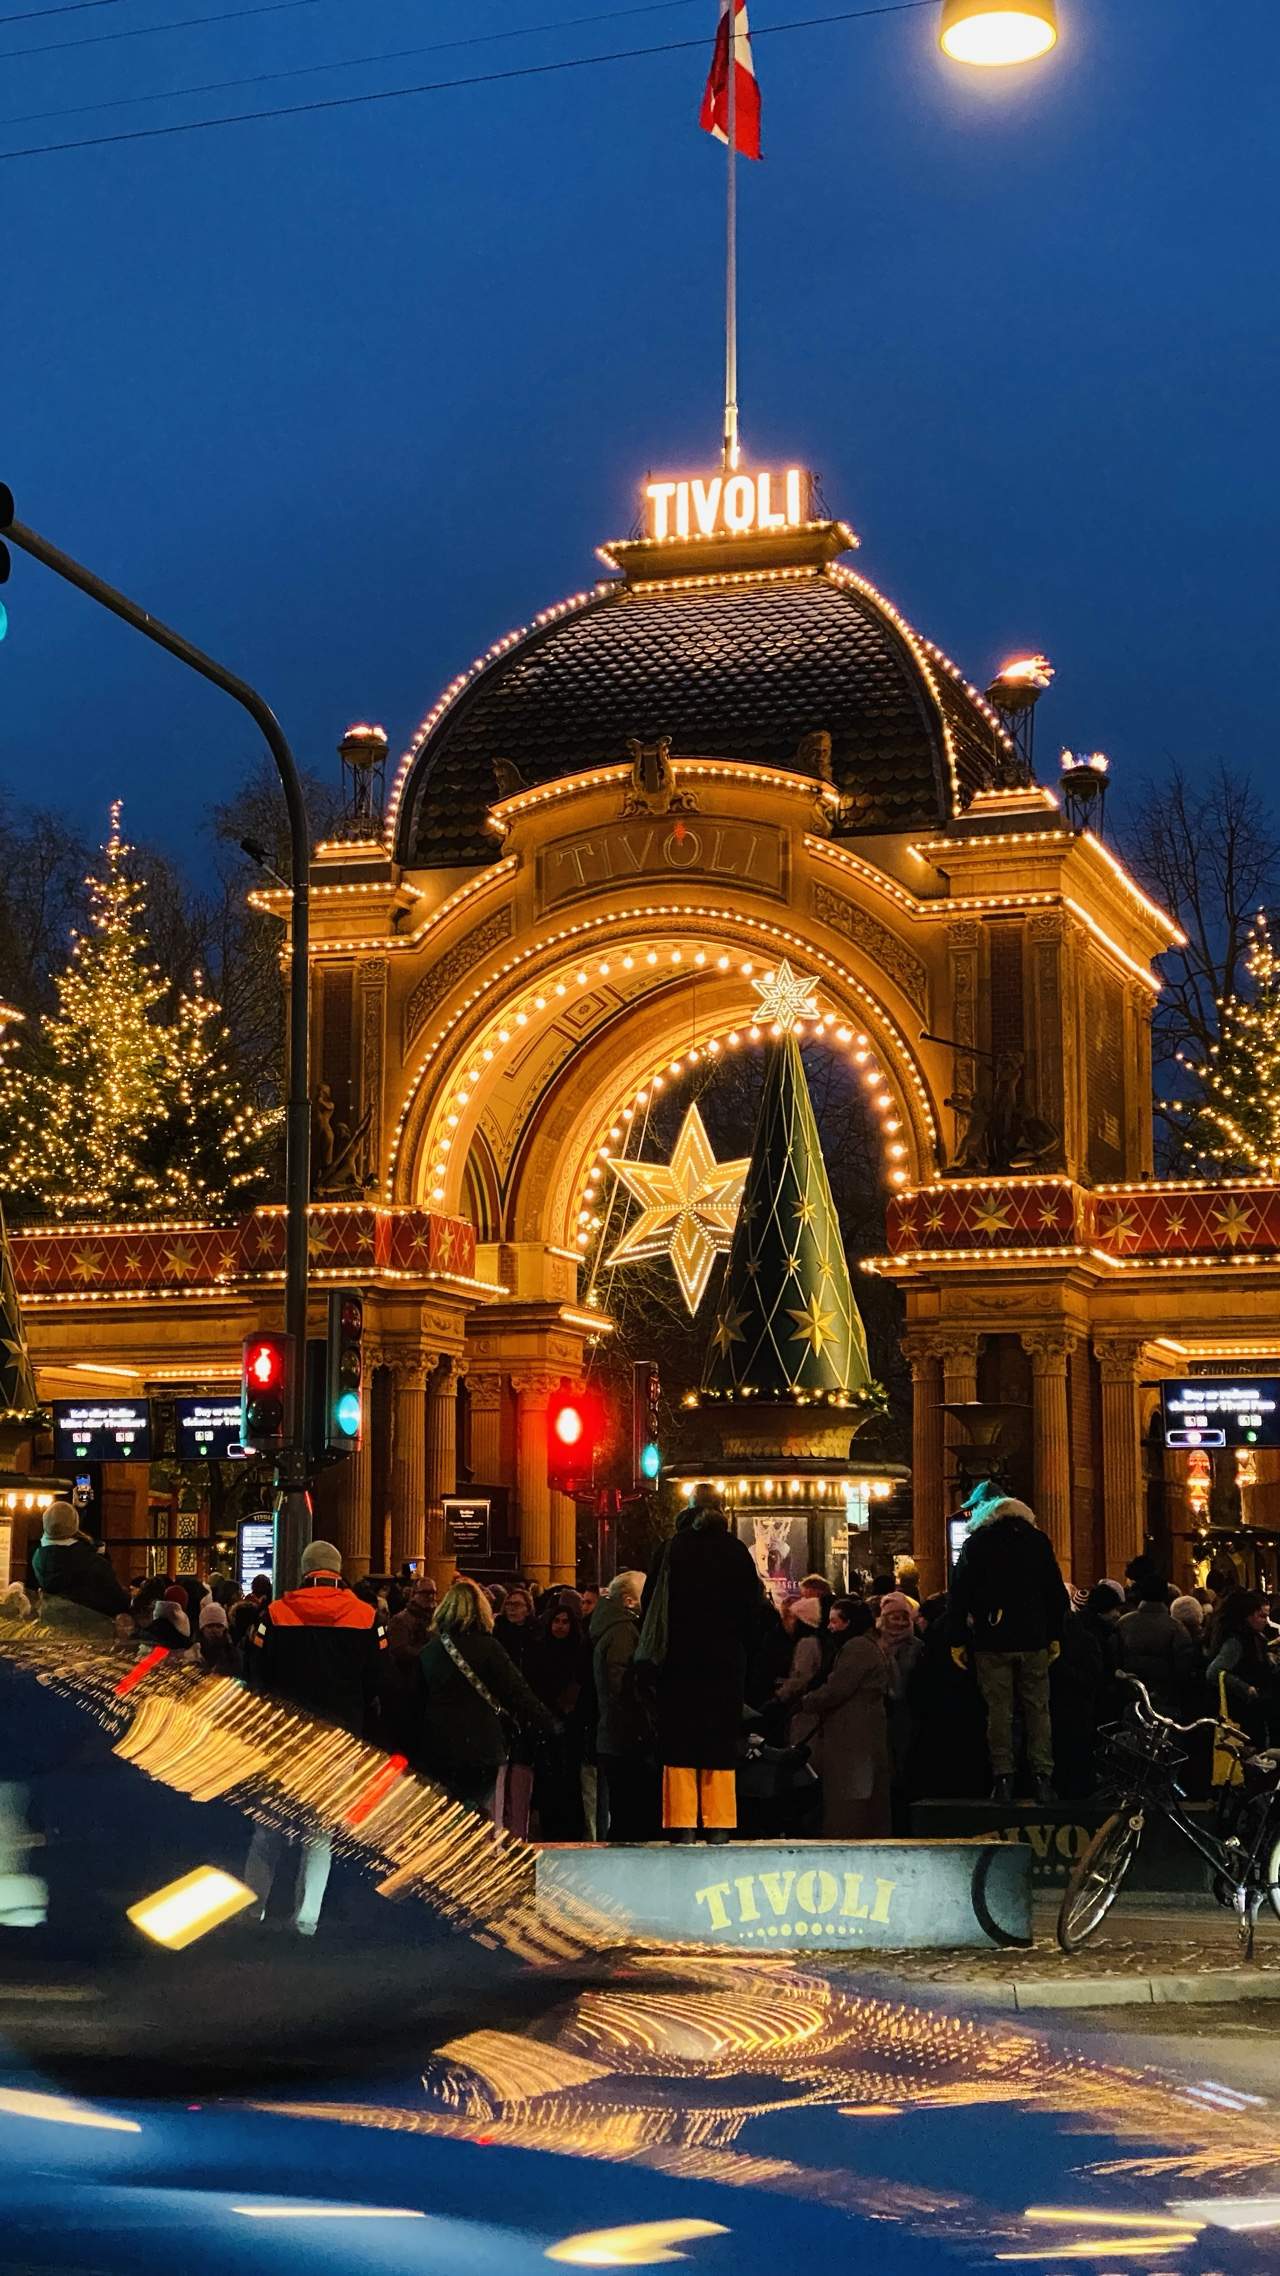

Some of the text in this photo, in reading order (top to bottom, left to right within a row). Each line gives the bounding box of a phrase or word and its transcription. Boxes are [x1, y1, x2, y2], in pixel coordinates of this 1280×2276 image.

[646, 469, 801, 541] TIVOLI
[557, 830, 763, 887] TIVOLI
[695, 1870, 897, 1931] TIVOLI
